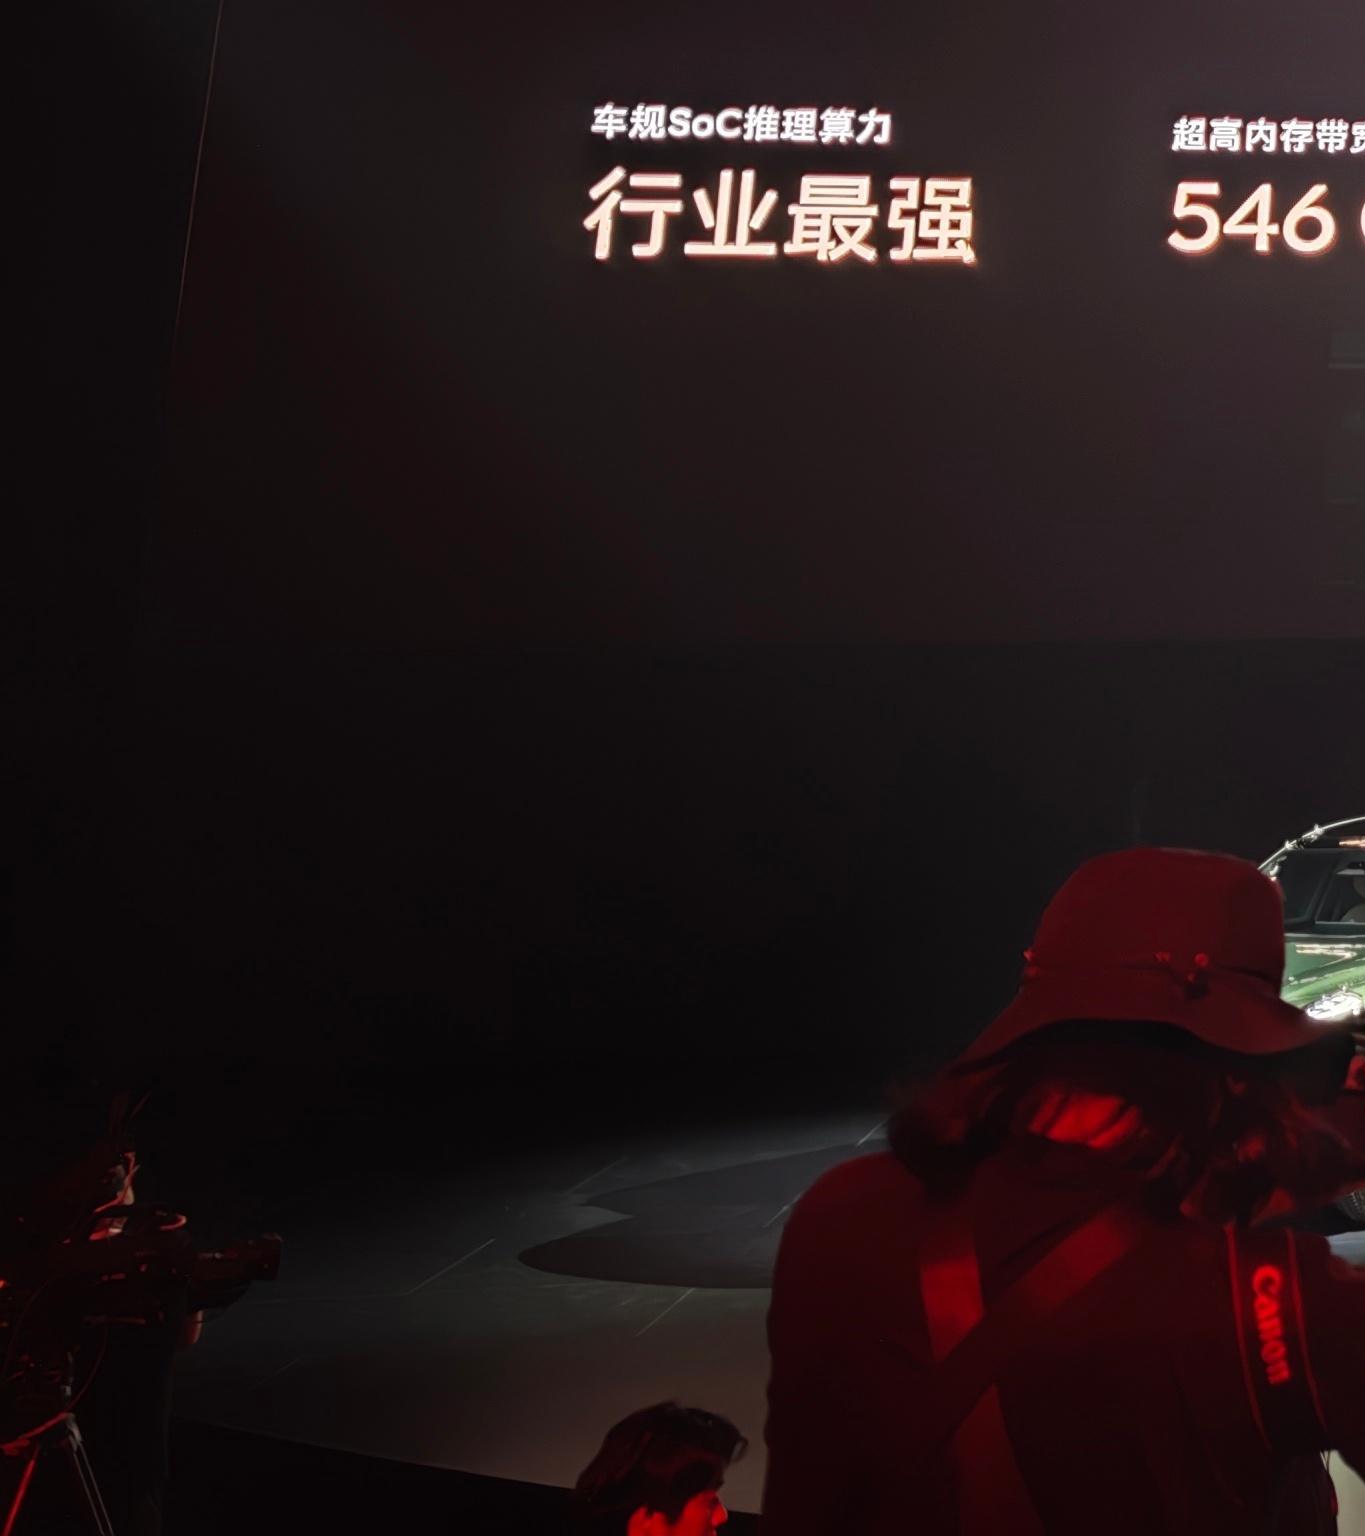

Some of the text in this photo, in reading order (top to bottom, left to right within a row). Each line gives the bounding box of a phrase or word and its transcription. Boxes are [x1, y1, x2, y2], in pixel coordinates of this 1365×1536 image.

[591, 103, 892, 145] 车规SoC推理算力
[583, 165, 977, 265] 行业最强
[1167, 181, 1336, 255] 546
[1252, 1266, 1290, 1384] Canon
